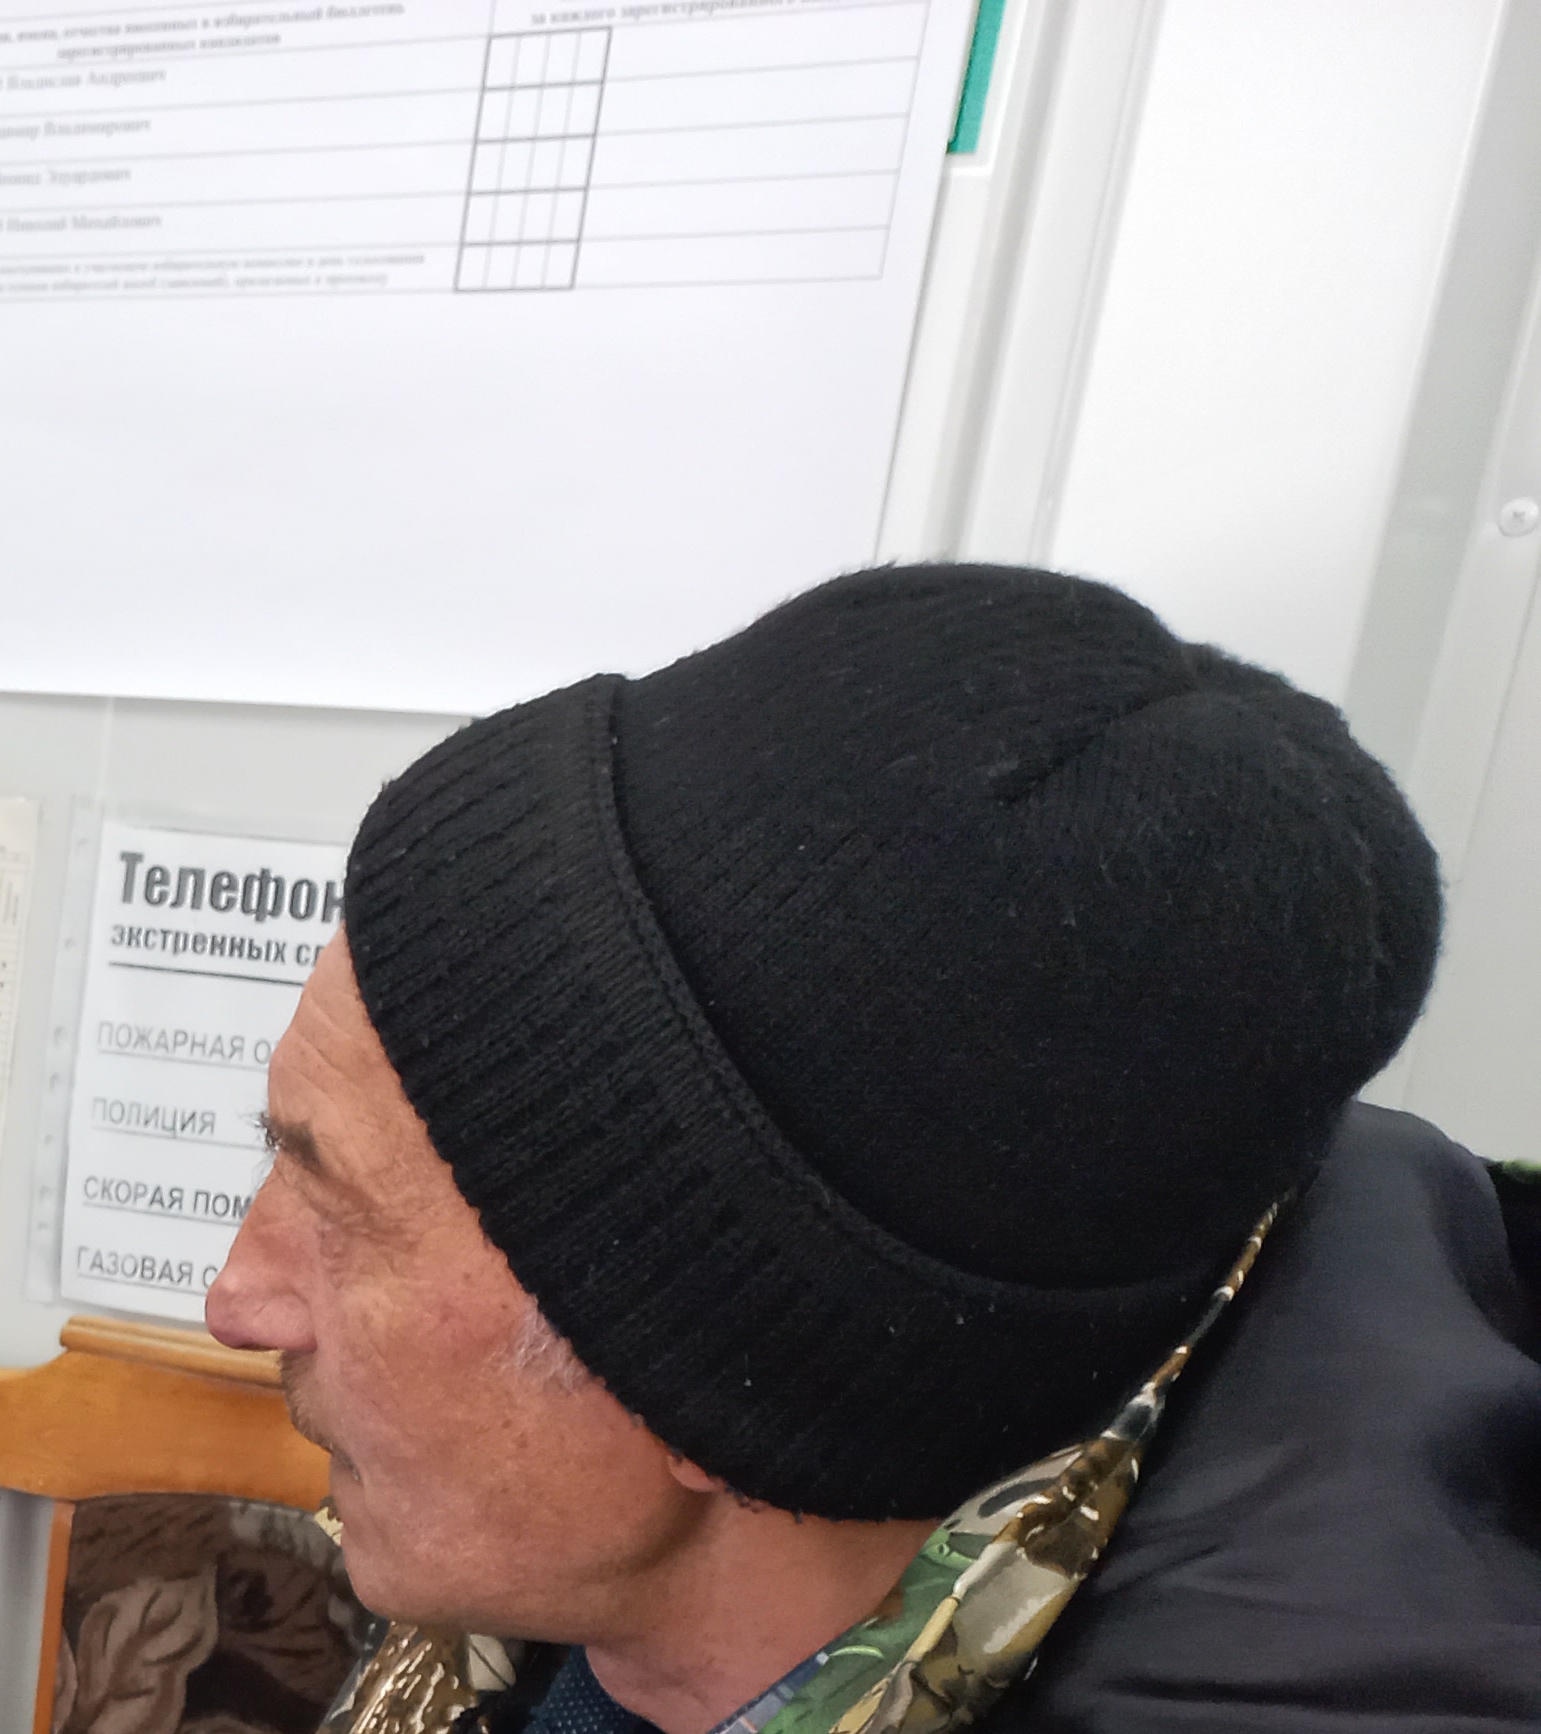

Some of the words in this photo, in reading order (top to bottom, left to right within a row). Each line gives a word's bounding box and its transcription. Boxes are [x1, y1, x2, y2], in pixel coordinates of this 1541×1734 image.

[110, 924, 287, 966] экстренных
[98, 1020, 245, 1061] ПОЖАРНАЯ
[93, 1096, 216, 1138] ПОЛИЦИЯ
[83, 1175, 184, 1211] СКОРАЯ
[192, 1190, 255, 1220] ПОМ
[77, 1245, 193, 1287] ГАЗОВАЯ
